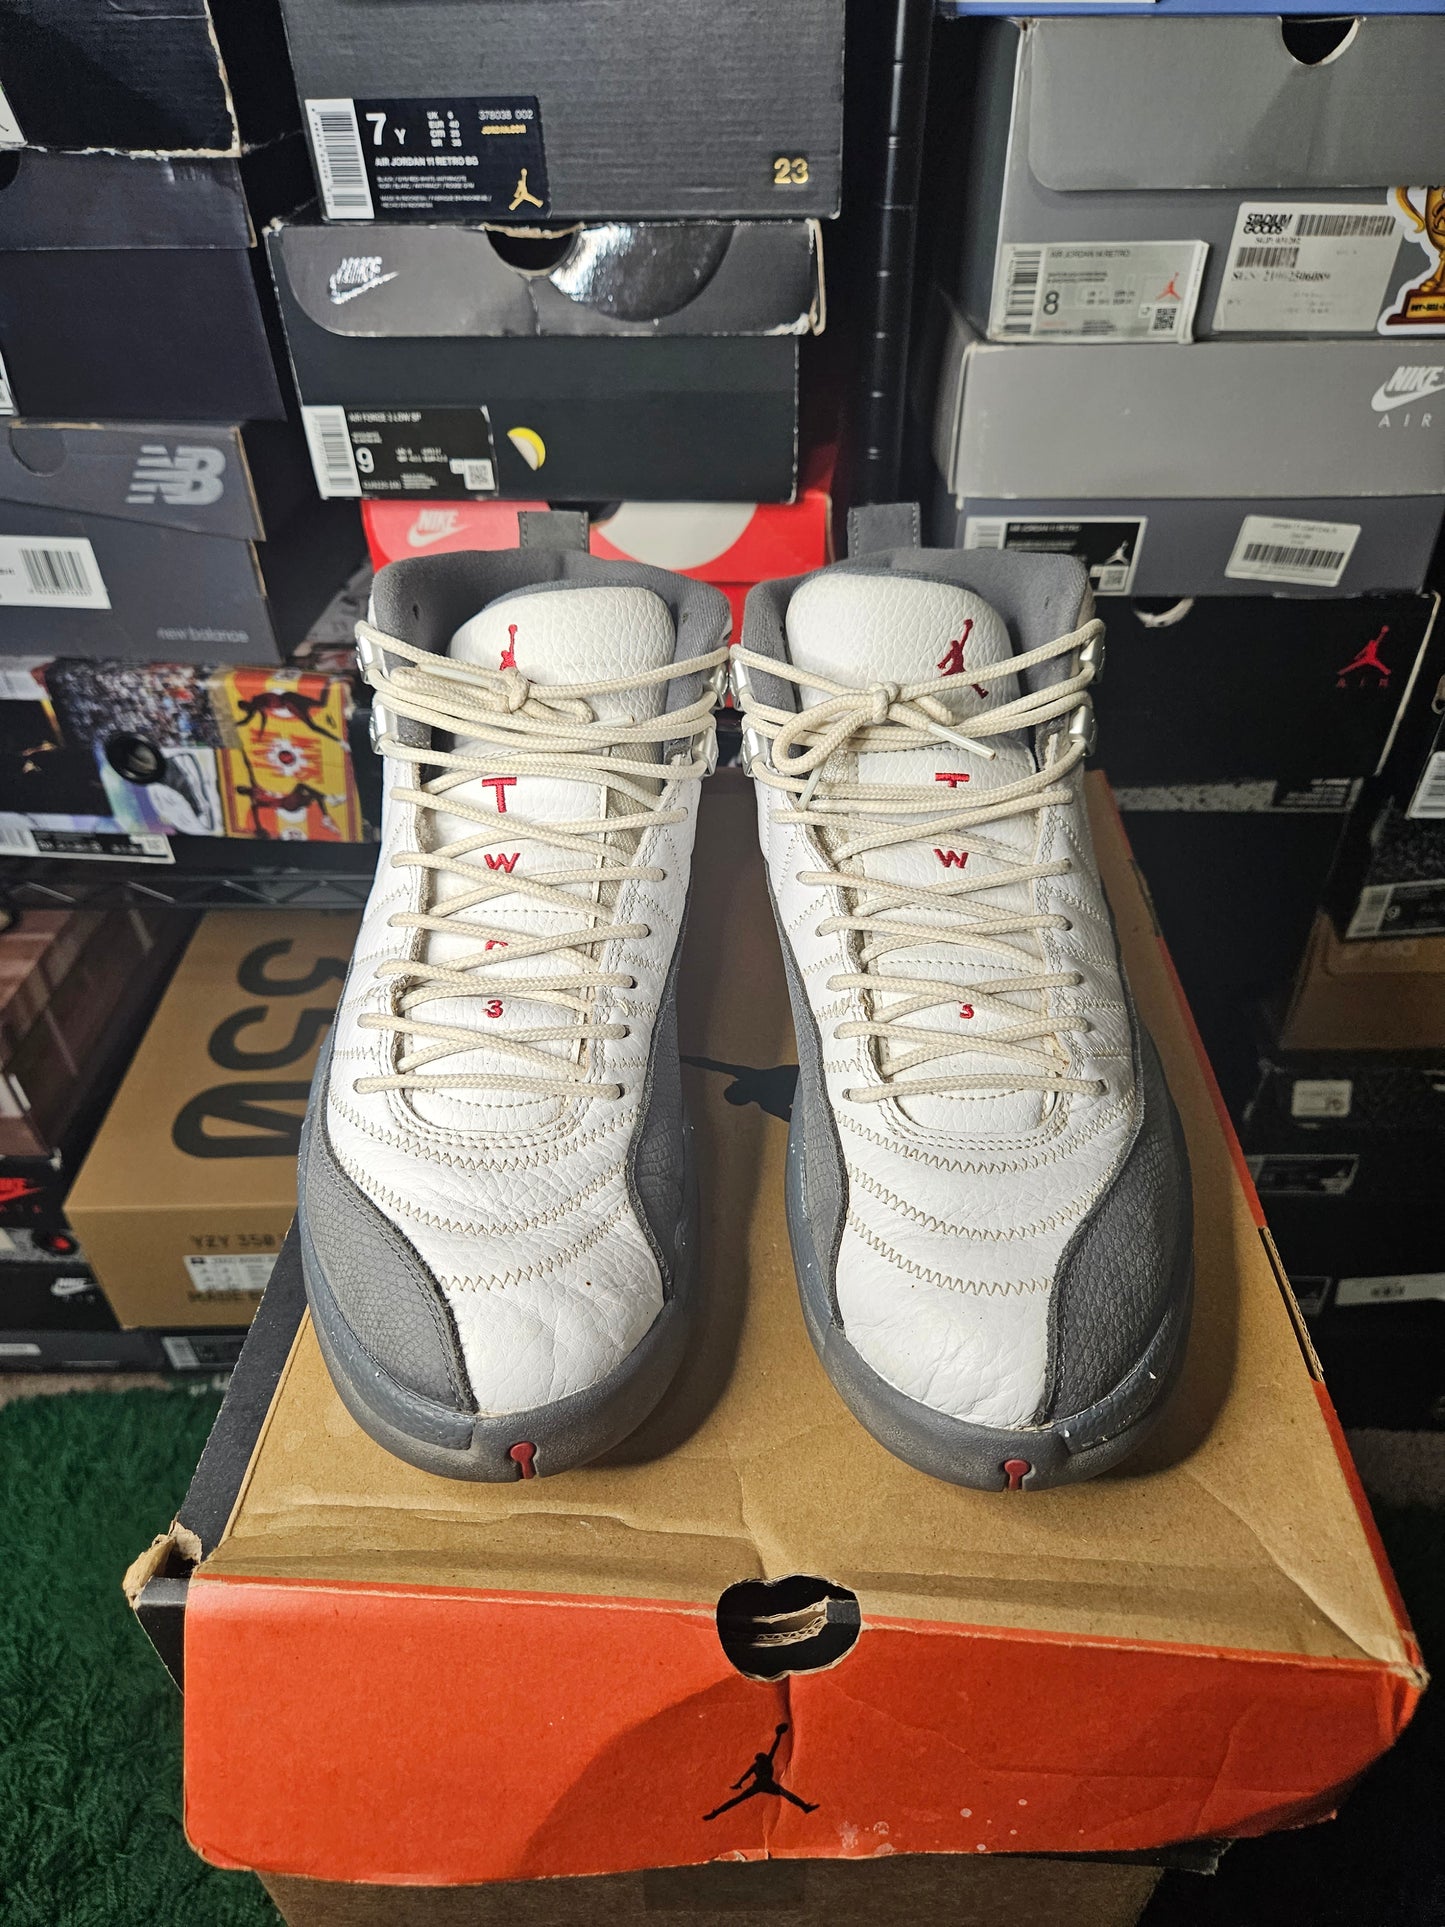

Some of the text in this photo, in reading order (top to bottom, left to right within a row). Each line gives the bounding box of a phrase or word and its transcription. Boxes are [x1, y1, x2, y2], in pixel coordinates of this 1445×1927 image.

[366, 112, 405, 146] 7 Y
[374, 157, 390, 167] AIR
[391, 156, 425, 167] JORDAN
[435, 155, 465, 166] RETRO
[773, 157, 809, 184] 23
[1243, 223, 1282, 235] GOODS
[1245, 213, 1292, 227] STADIUM
[336, 256, 382, 284] NIKE
[1043, 291, 1060, 315] 8
[1385, 366, 1444, 392] NIKE
[1378, 413, 1432, 428] AIR
[355, 447, 375, 473] 9
[416, 509, 458, 532] NIKE
[157, 628, 248, 643] new balance
[933, 848, 969, 870] W
[482, 777, 520, 1019] T W 3
